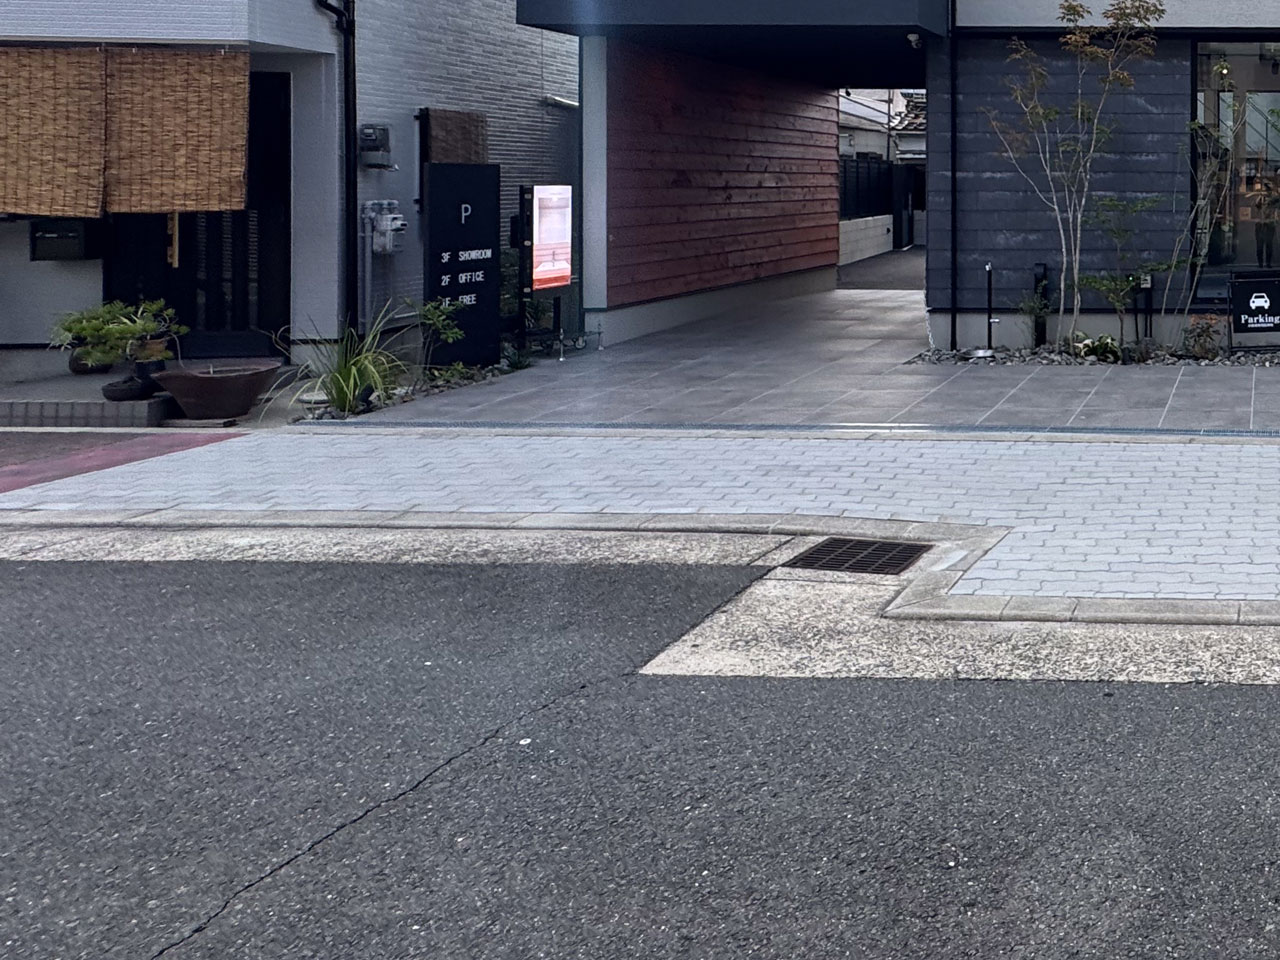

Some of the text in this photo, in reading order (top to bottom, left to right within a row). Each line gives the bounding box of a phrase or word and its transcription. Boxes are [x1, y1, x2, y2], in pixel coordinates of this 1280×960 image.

[461, 203, 472, 224] P
[440, 248, 492, 263] 3F SHOWROOM
[440, 271, 485, 286] 2F OFFICE
[458, 294, 477, 305] FREE
[1240, 314, 1280, 324] Parking
